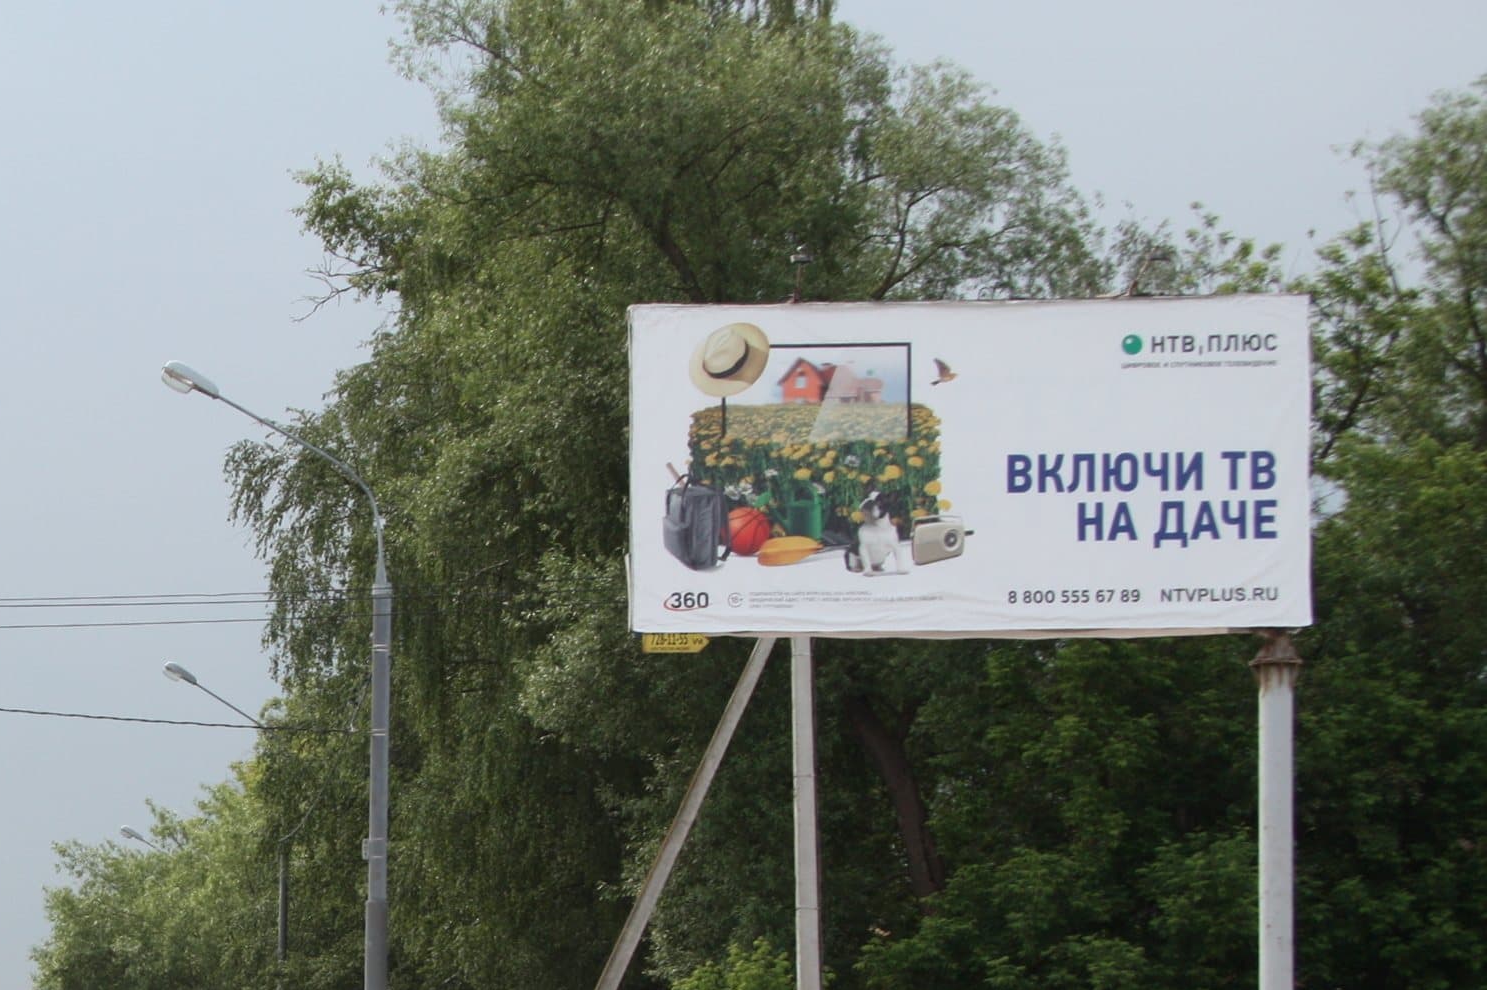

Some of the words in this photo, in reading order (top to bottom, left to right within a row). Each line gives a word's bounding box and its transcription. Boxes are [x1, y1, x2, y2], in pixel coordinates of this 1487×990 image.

[1207, 333, 1278, 352] ПЛЮС
[1006, 453, 1204, 494] ВКЛЮЧИ
[1221, 451, 1277, 491] ТВ
[1077, 501, 1139, 542] НА
[1154, 500, 1278, 548] ДАЧЕ
[670, 591, 710, 609] 360
[1008, 590, 1017, 604] 8
[1023, 590, 1055, 604] 800
[1061, 589, 1090, 603] 555
[1096, 589, 1114, 603] 67
[1121, 588, 1141, 603] 89
[1161, 586, 1279, 602] NTVPLUS.RU
